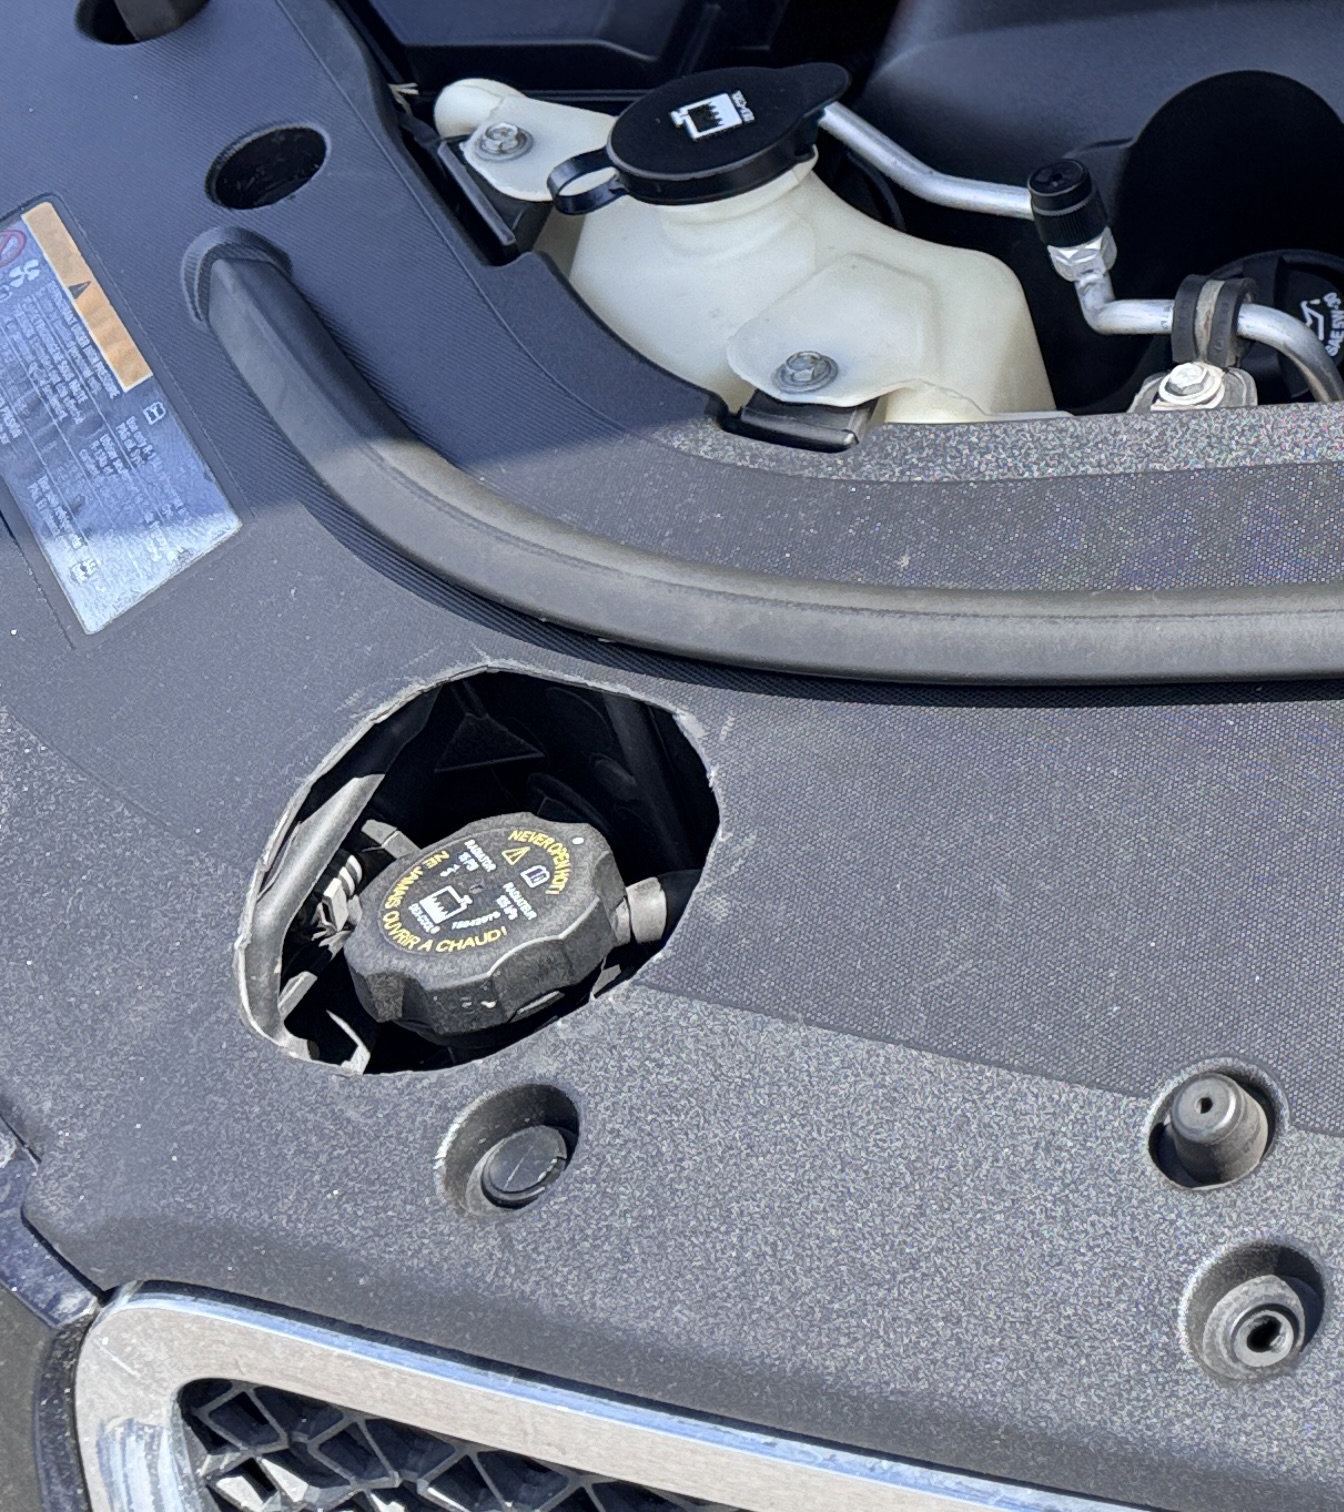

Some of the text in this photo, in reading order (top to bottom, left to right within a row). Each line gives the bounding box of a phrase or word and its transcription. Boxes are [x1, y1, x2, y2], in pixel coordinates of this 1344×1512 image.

[422, 850, 450, 869] NE
[464, 839, 497, 873] RADIATOR
[508, 830, 571, 895] NEVER OPEN HOT!
[385, 865, 424, 909] JAMAIS
[383, 910, 421, 950] OUVRIR
